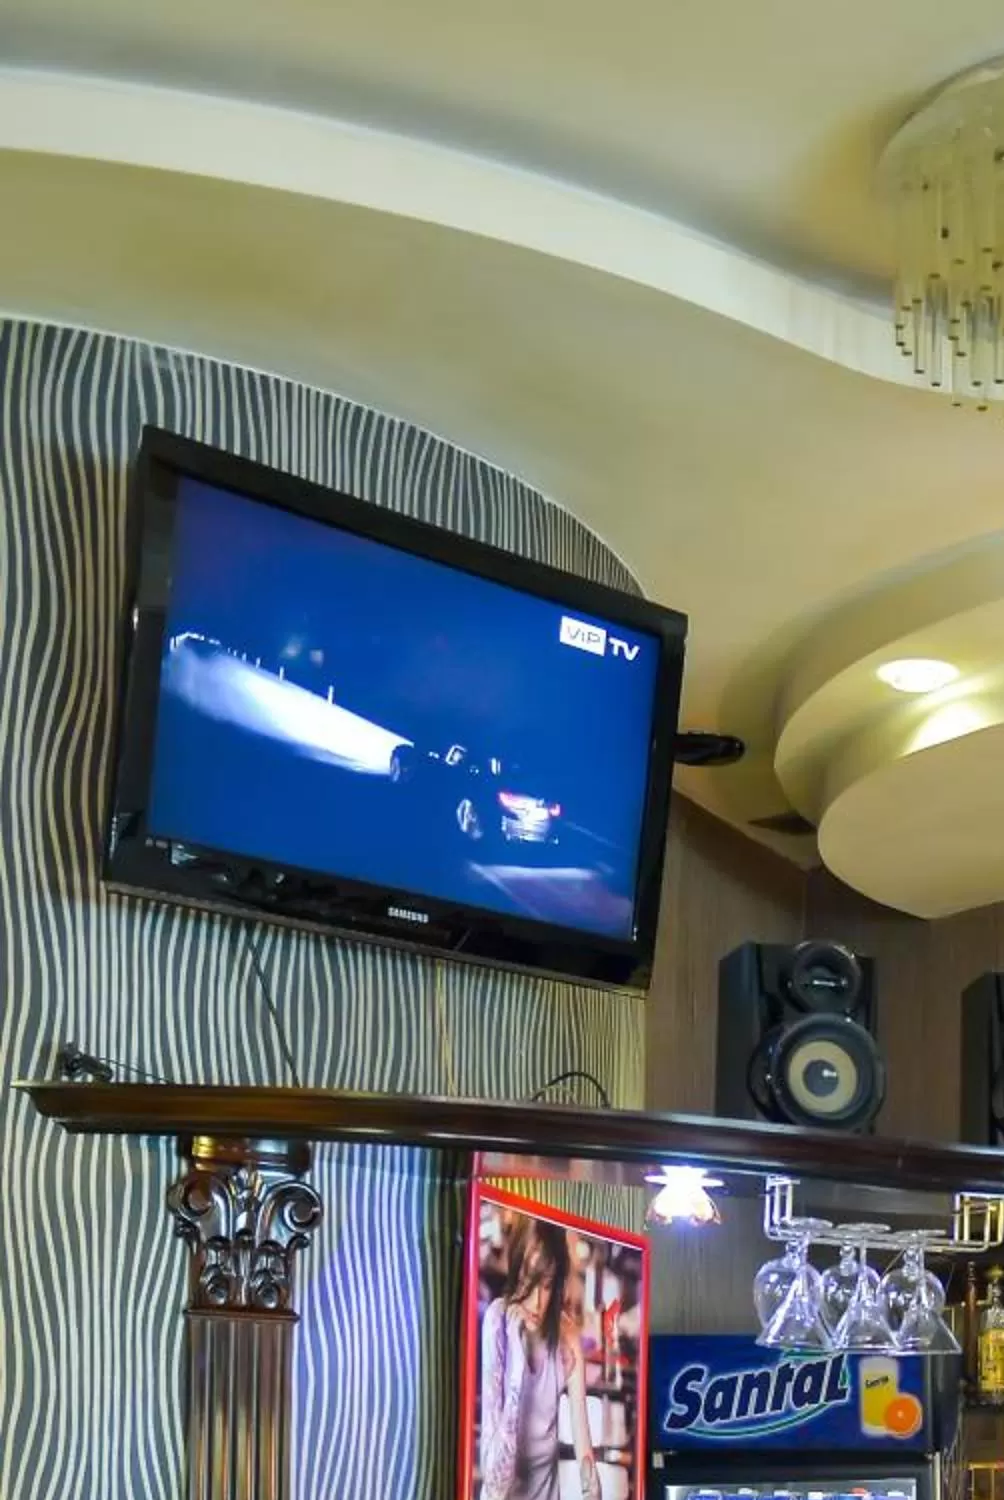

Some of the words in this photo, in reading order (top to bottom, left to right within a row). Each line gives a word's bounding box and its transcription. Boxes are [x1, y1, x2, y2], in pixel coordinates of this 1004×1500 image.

[608, 636, 641, 661] TV
[388, 907, 429, 924] SAMSUNG
[665, 1352, 849, 1430] Santal
